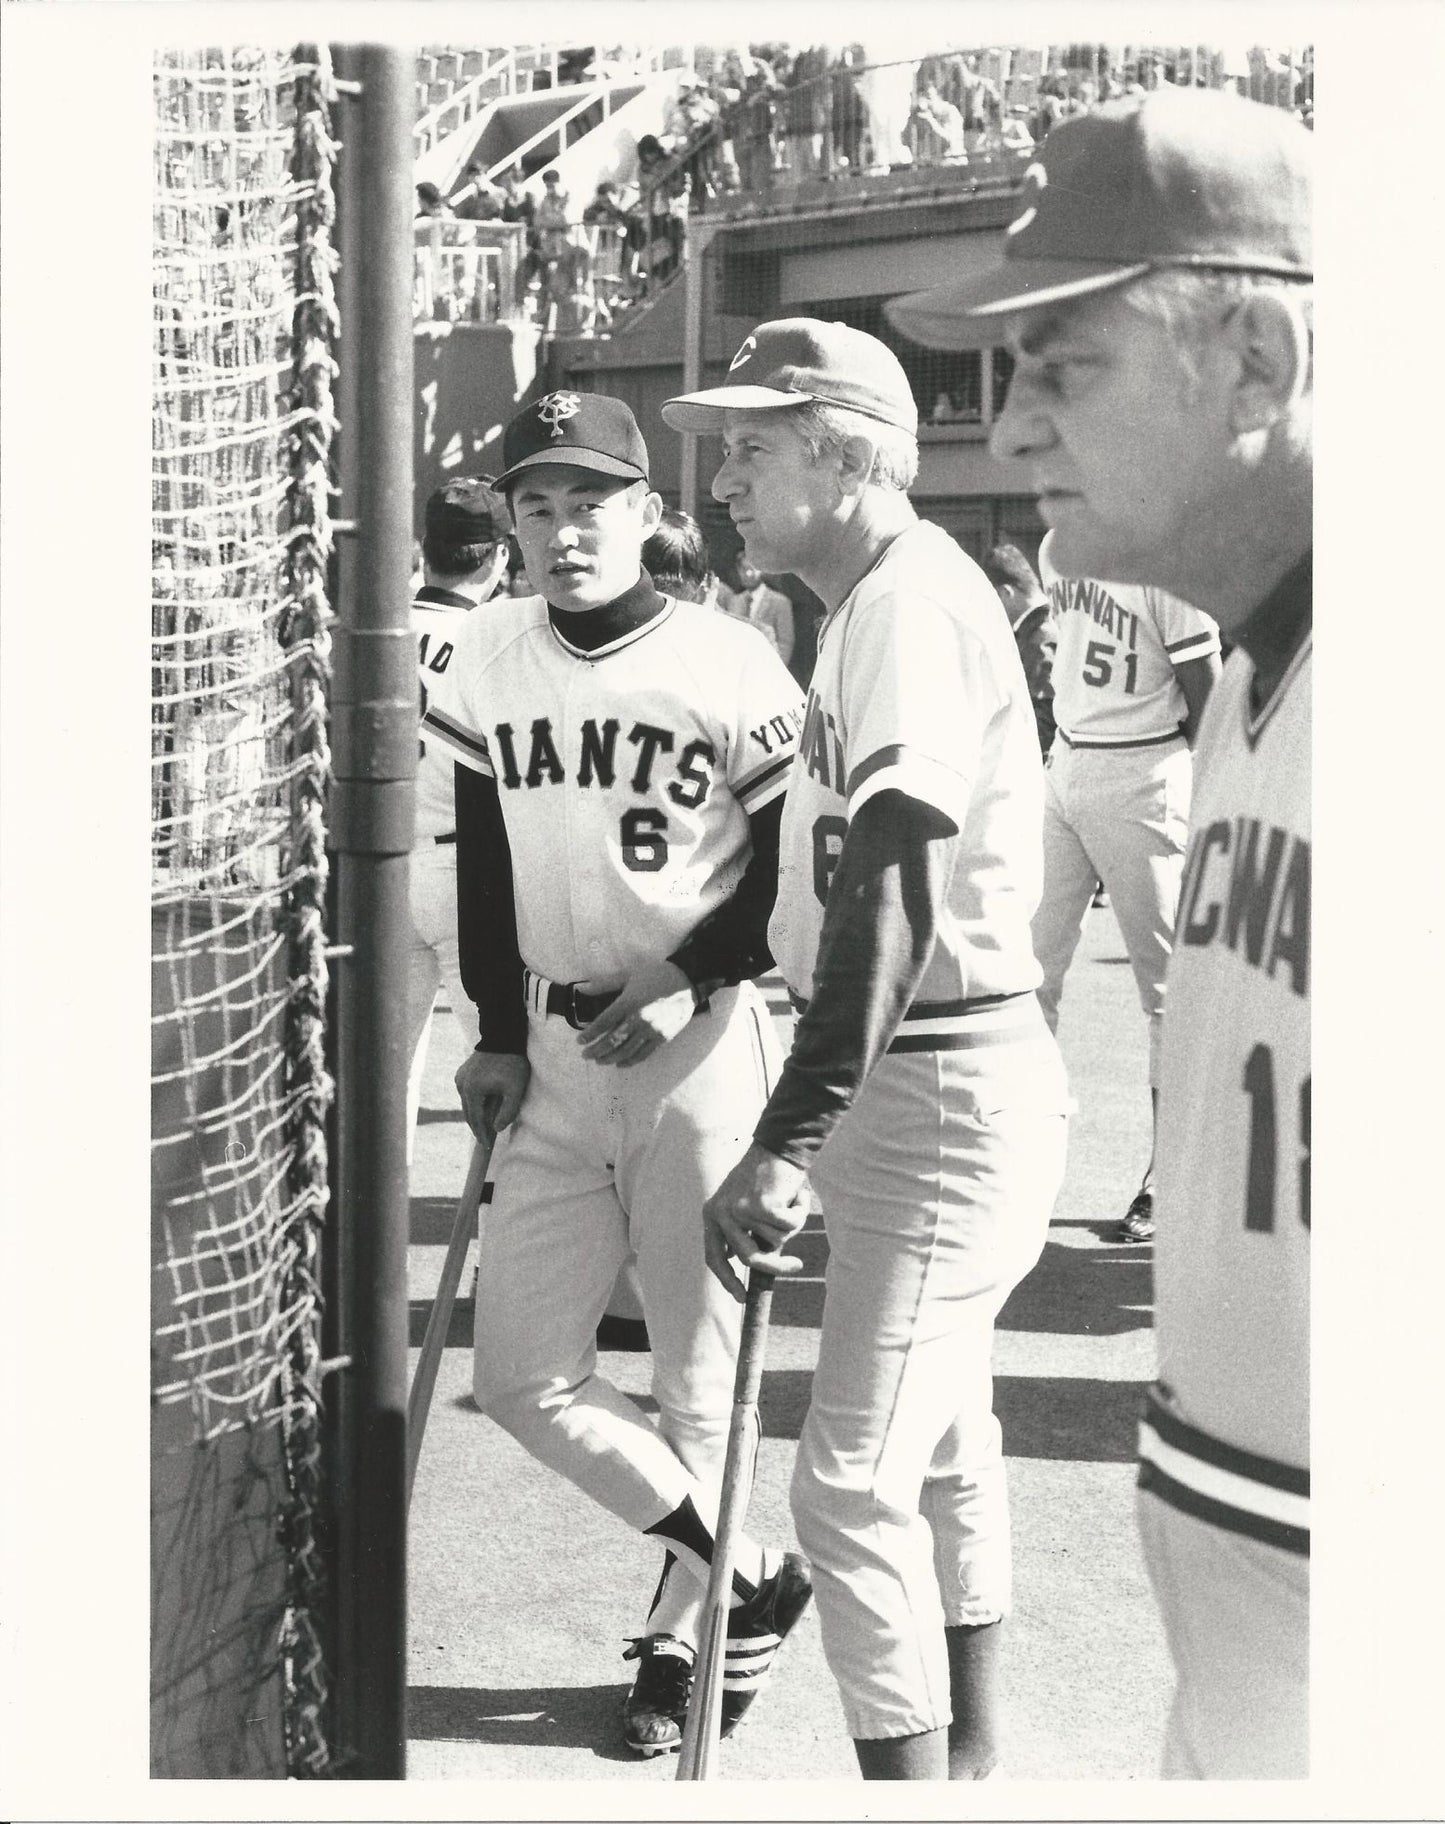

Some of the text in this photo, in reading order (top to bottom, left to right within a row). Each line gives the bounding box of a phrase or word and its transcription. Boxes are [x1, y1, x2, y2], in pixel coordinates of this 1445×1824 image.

[730, 336, 757, 371] C
[1082, 640, 1138, 694] 51
[620, 806, 668, 872] 6
[1242, 1041, 1311, 1232] 1
